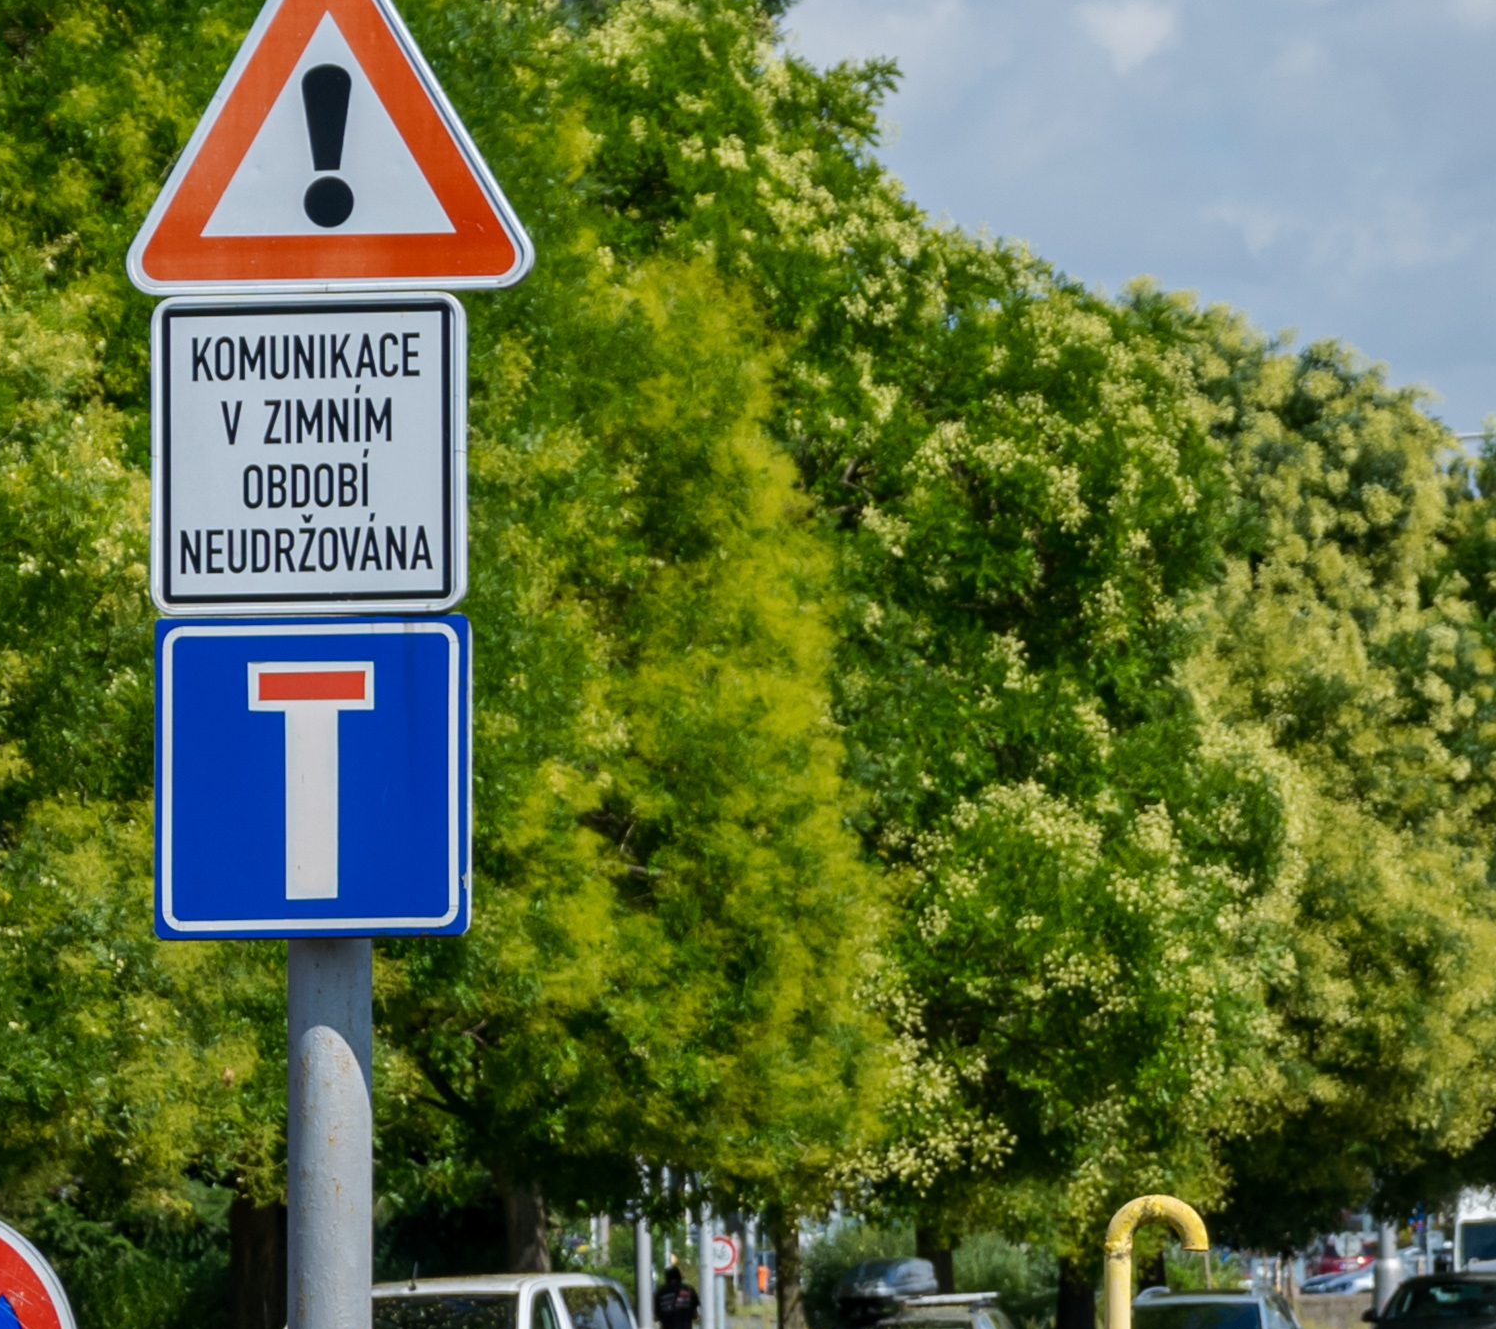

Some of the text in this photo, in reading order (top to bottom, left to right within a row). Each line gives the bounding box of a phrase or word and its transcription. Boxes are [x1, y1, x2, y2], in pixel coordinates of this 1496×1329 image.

[191, 332, 420, 382] KOMUNIKACE
[221, 384, 392, 445] V ZIMNÍM
[242, 448, 370, 510] OBDOBÍ
[180, 512, 434, 575] NEUDRŽOVÁNA
